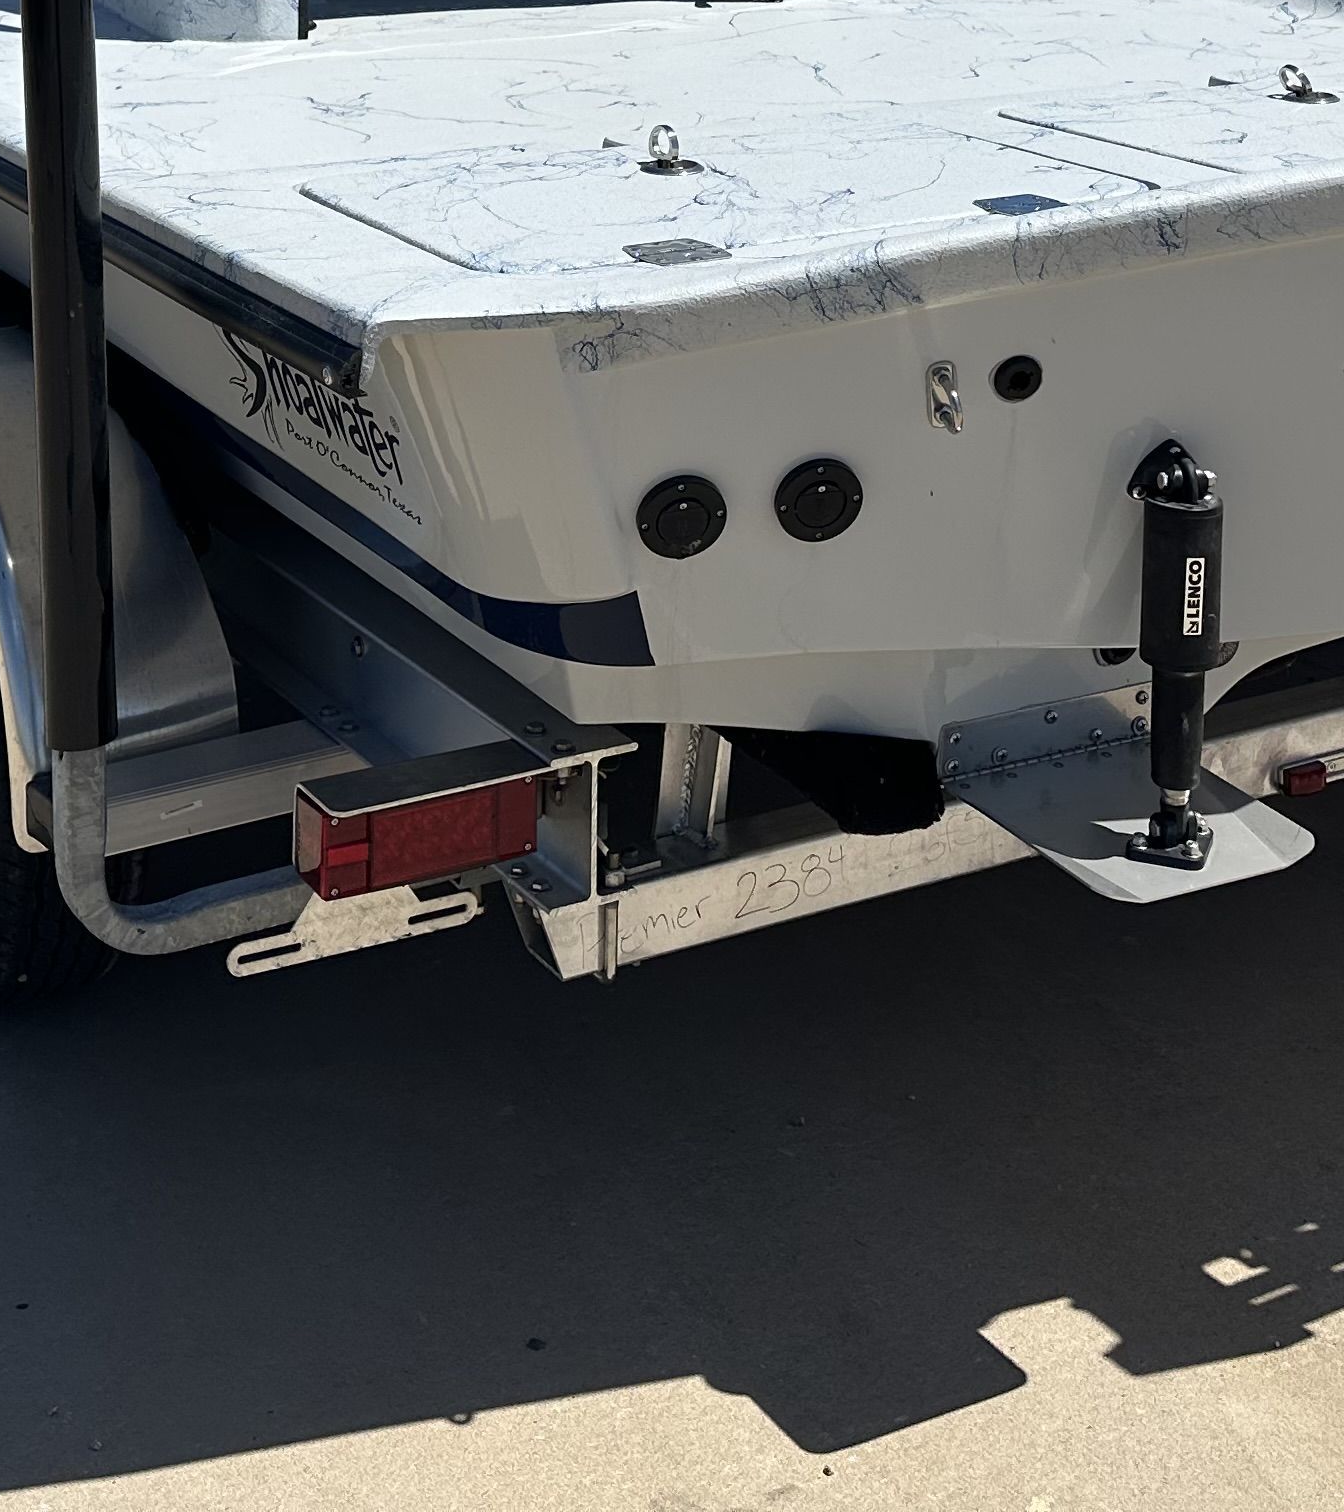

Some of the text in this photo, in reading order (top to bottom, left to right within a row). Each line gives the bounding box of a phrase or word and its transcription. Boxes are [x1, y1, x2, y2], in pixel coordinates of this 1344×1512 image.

[220, 326, 404, 486] Shoalwater
[1186, 559, 1203, 619] LENCO
[734, 843, 846, 919] 2384
